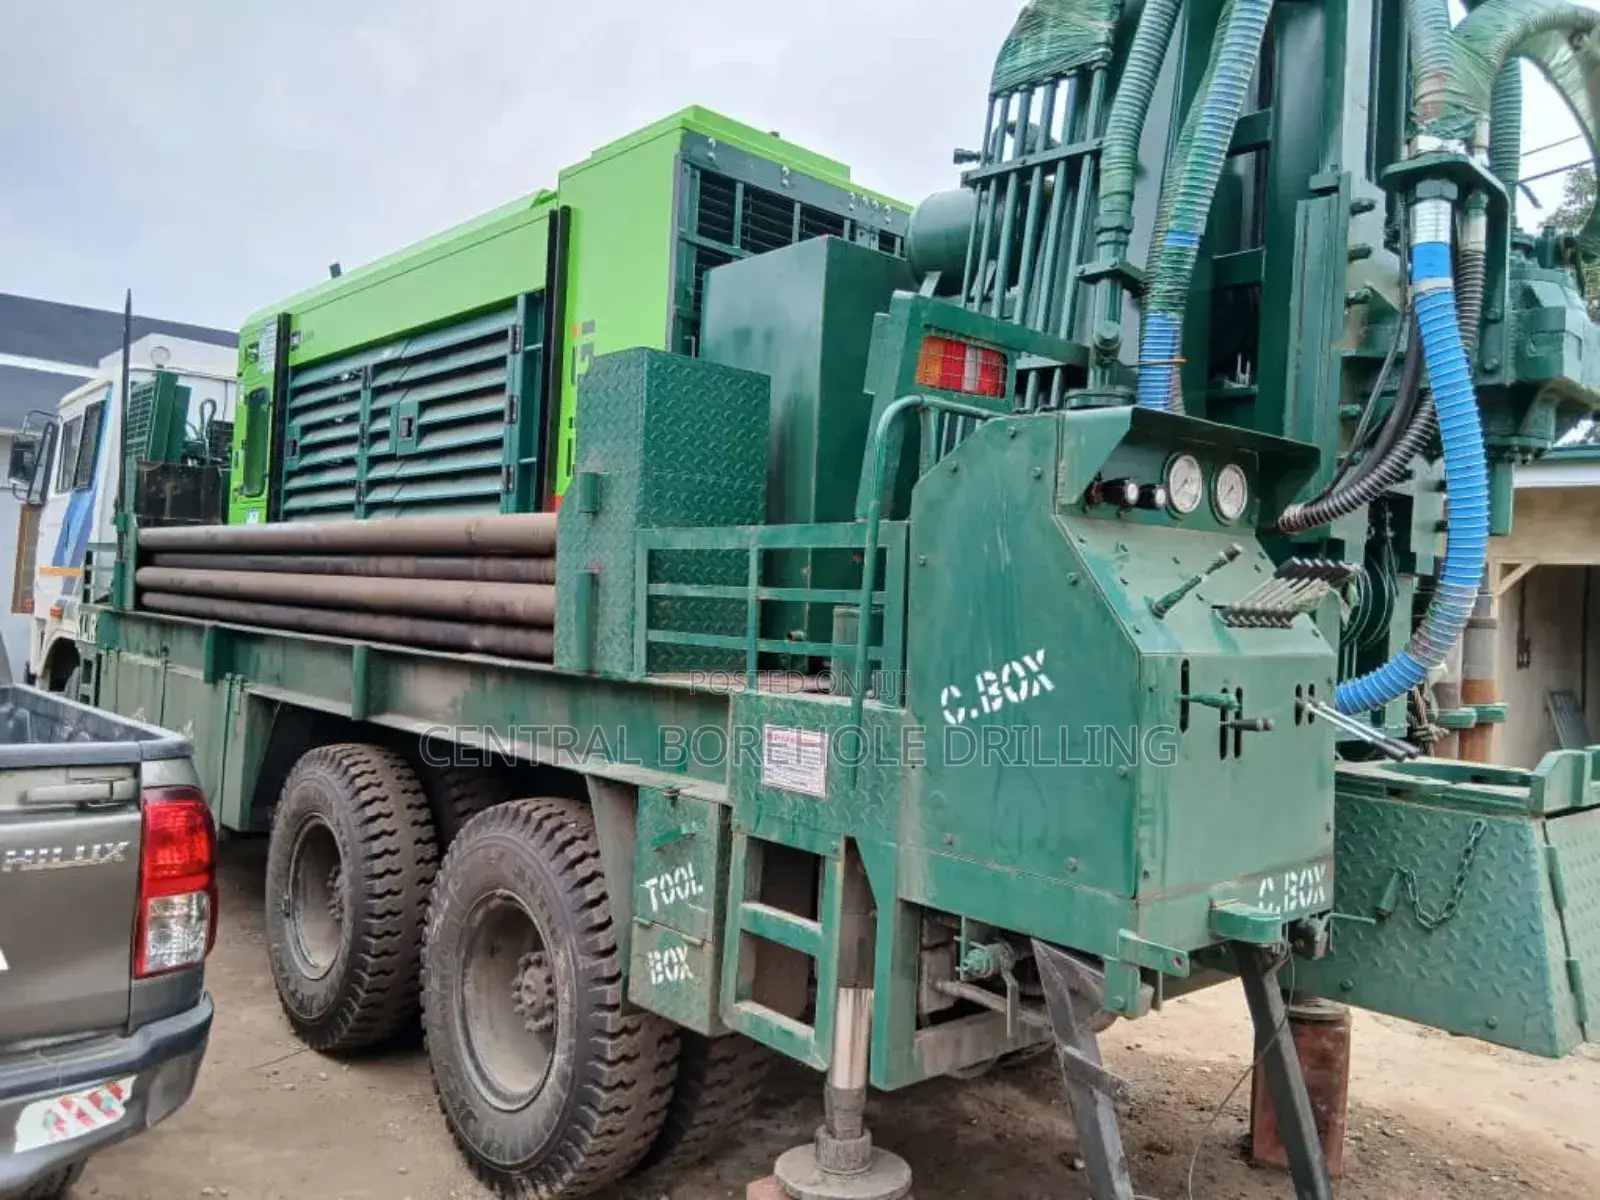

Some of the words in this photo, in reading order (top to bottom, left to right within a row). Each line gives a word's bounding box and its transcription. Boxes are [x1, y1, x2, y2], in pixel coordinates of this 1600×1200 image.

[940, 648, 1055, 726] C.BOX
[2, 841, 129, 872] HILUX
[643, 862, 704, 914] TOOL
[647, 944, 694, 985] BOX
